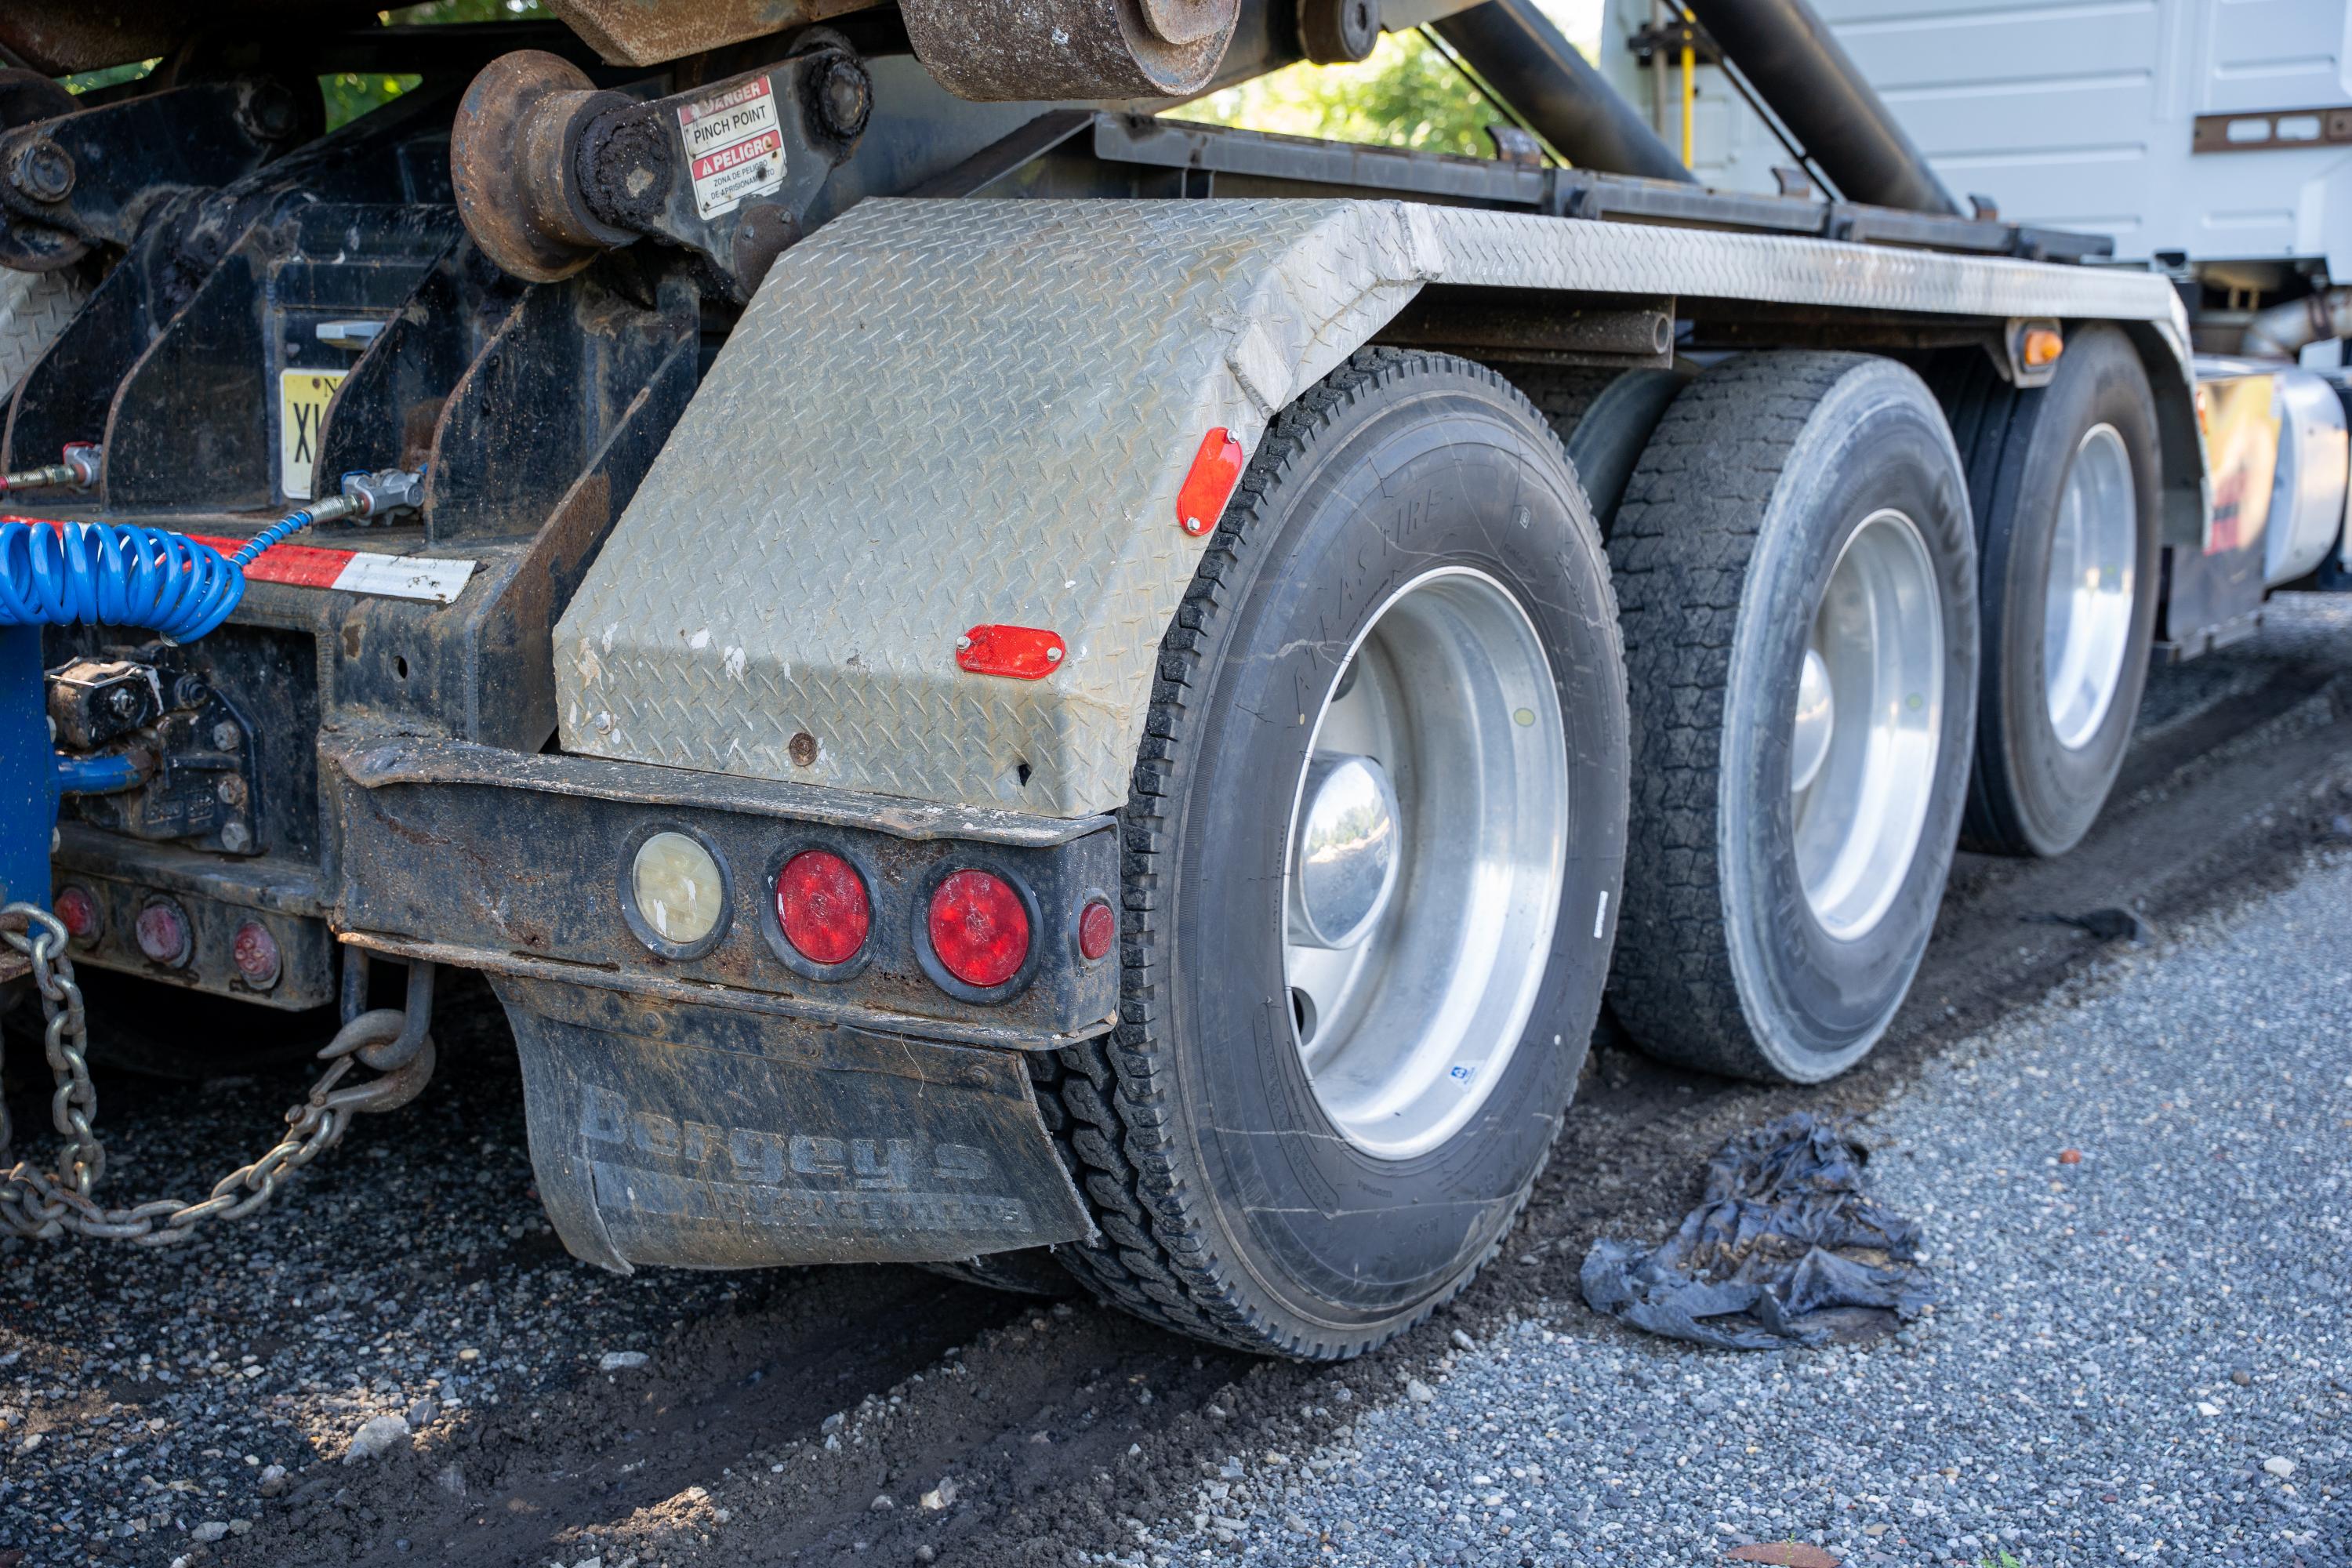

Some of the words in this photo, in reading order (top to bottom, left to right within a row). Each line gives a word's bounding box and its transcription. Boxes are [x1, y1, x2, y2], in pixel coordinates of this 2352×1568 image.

[693, 118, 731, 144] PINCH
[732, 105, 766, 129] POINT
[713, 136, 772, 171] PELIGRO
[710, 190, 720, 201] DE
[721, 169, 775, 196] APRISIONAMTO
[713, 174, 731, 187] ZONA
[731, 170, 741, 180] DE
[742, 159, 768, 176] PELIGRO
